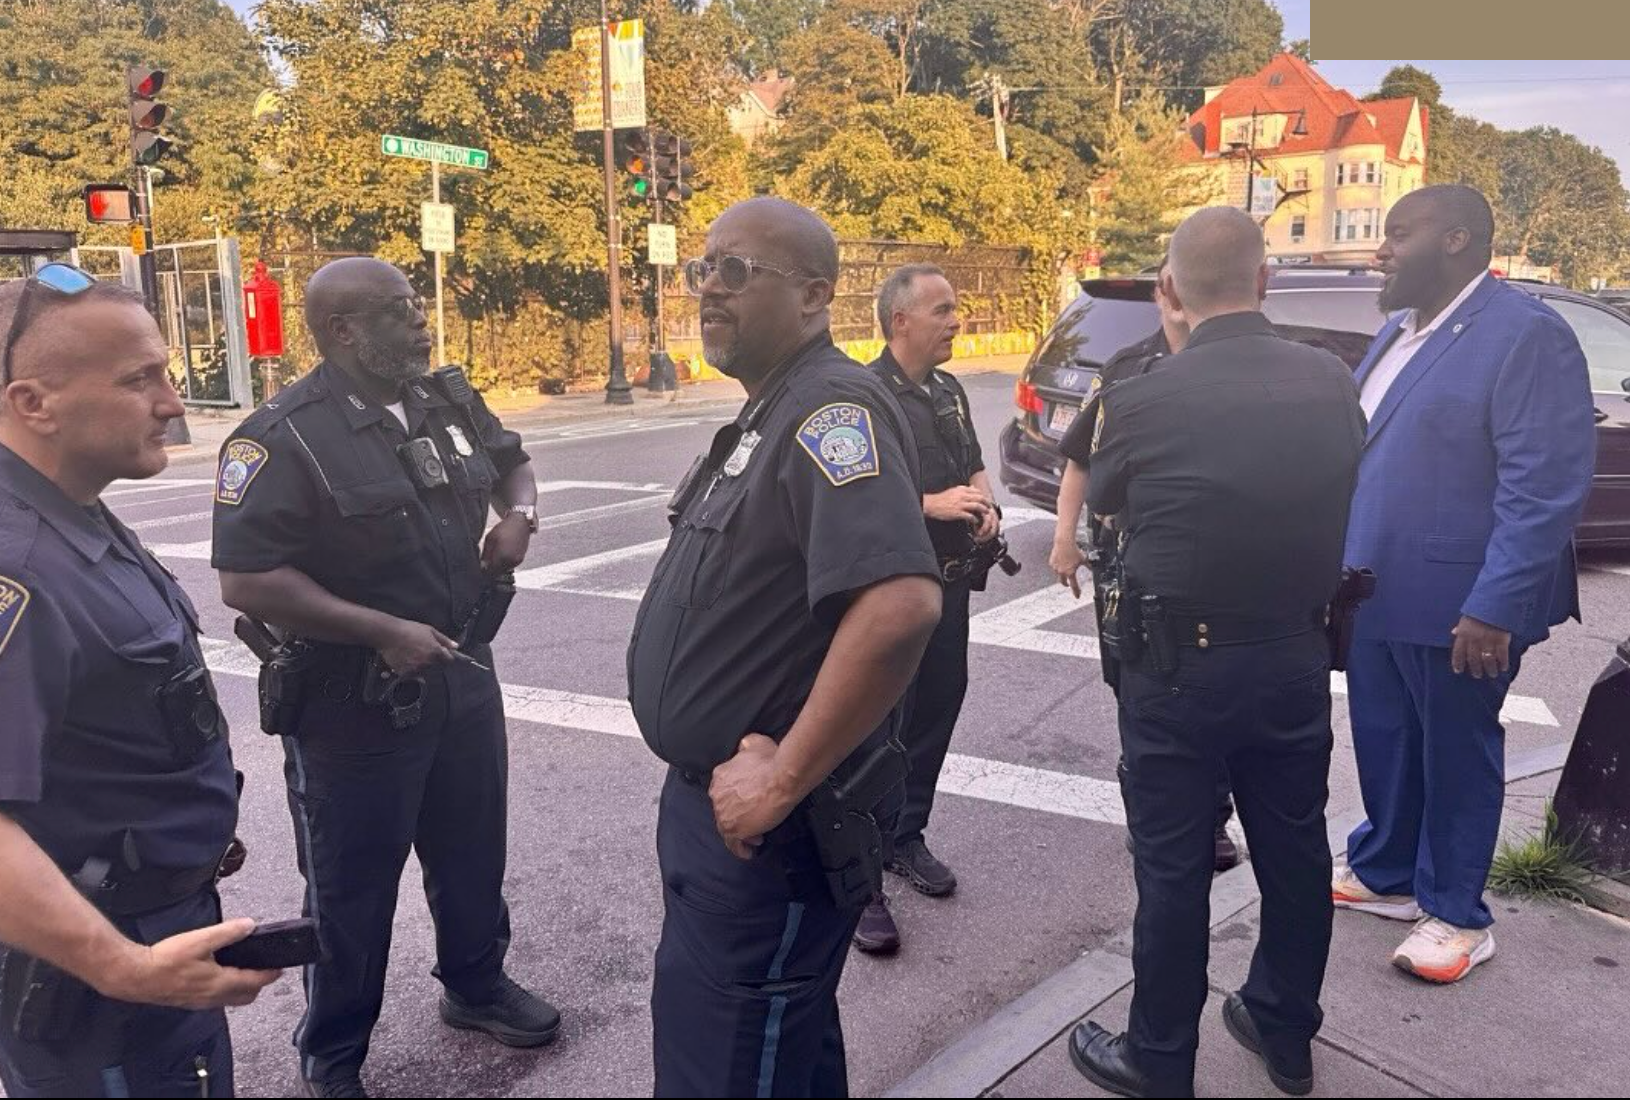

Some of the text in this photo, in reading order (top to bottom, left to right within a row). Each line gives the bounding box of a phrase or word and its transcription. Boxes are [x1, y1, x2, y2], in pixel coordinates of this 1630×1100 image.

[402, 141, 469, 164] WASHINGTON
[804, 407, 861, 436] BOSTON
[811, 416, 859, 438] POLICE
